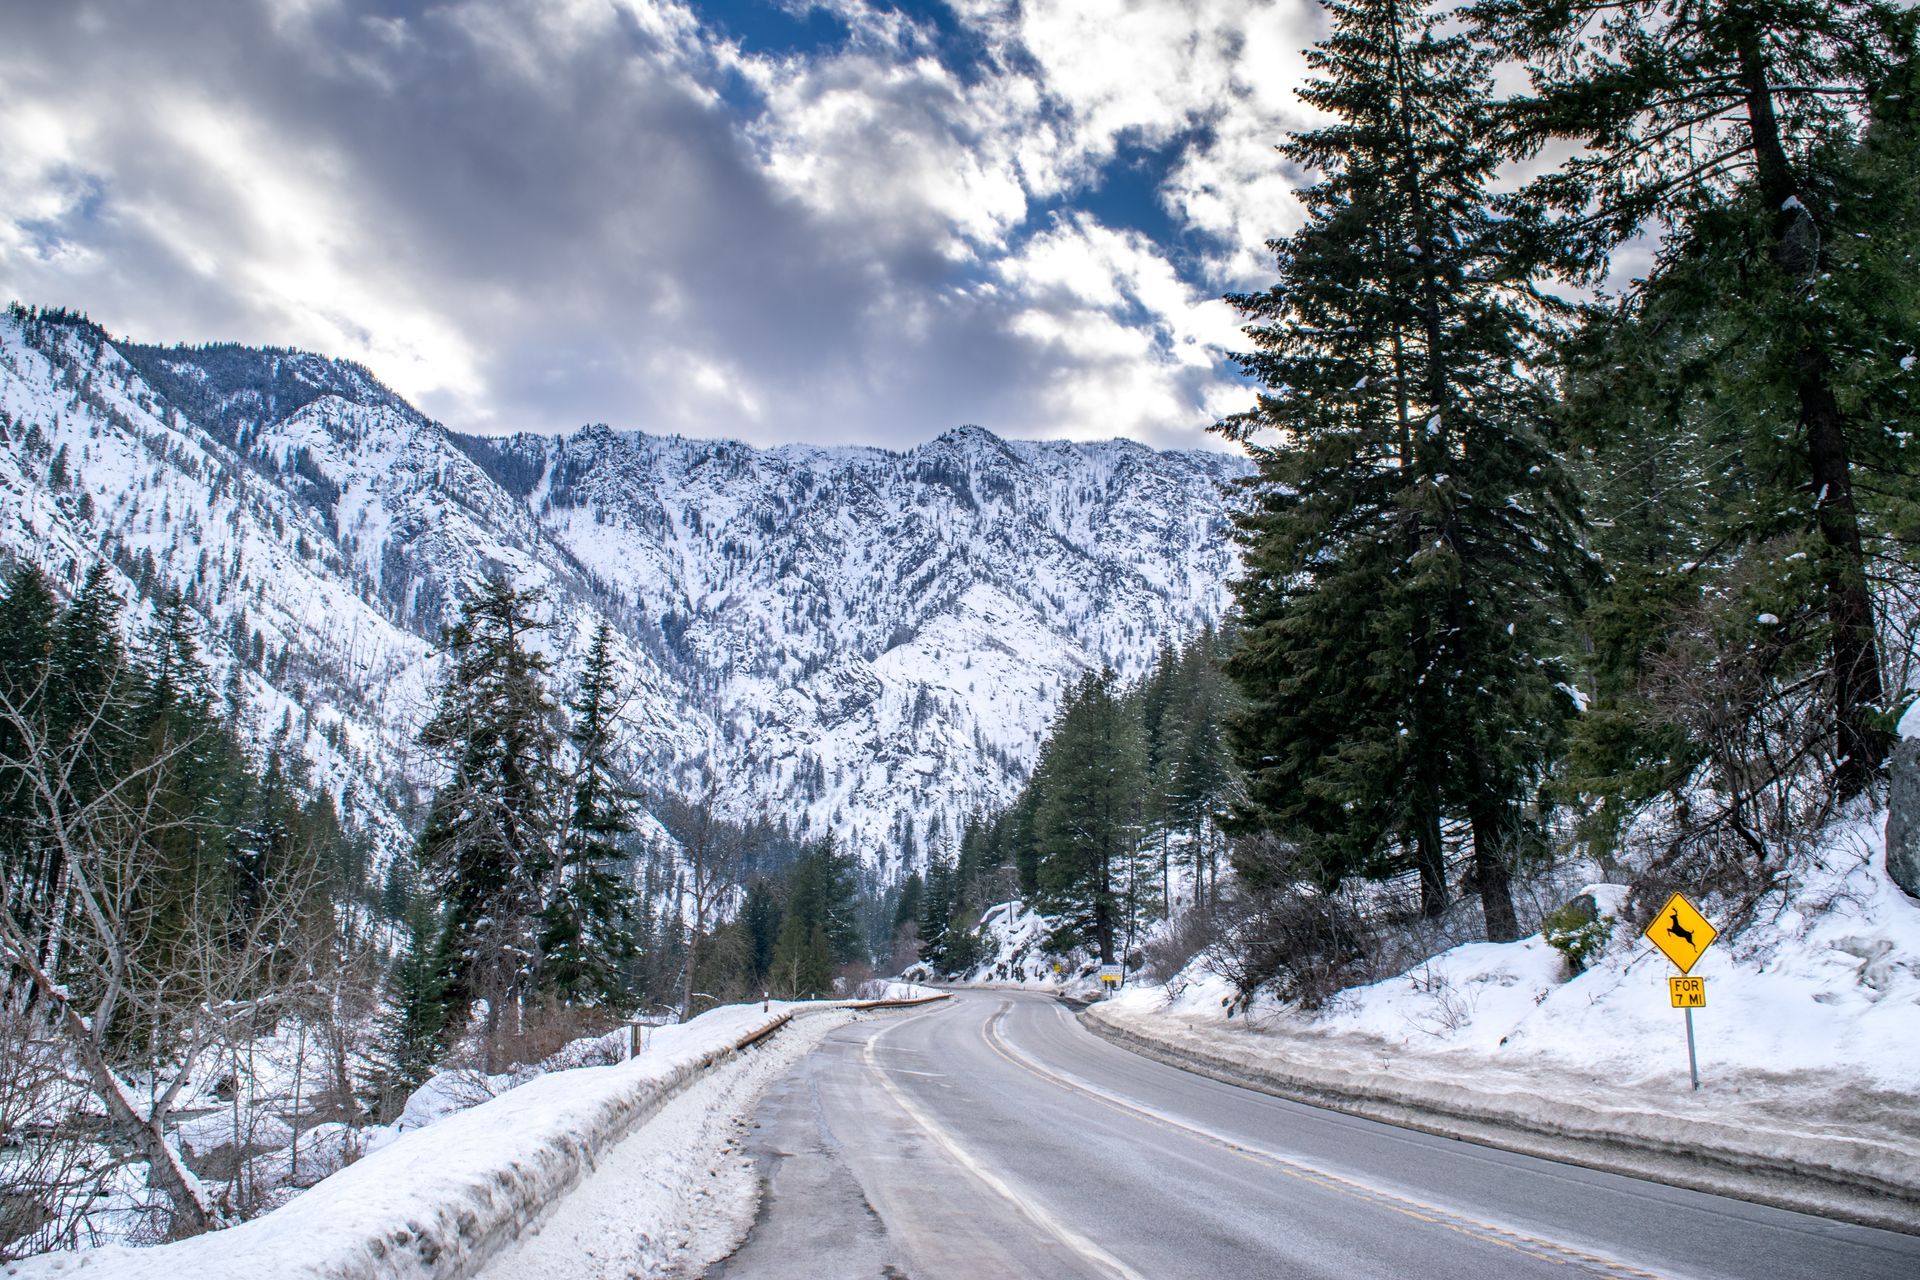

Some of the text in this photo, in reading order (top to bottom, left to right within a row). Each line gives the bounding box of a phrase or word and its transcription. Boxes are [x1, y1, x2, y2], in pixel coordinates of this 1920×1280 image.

[1675, 980, 1699, 991] FOR
[1675, 994, 1702, 1005] 7 MI
